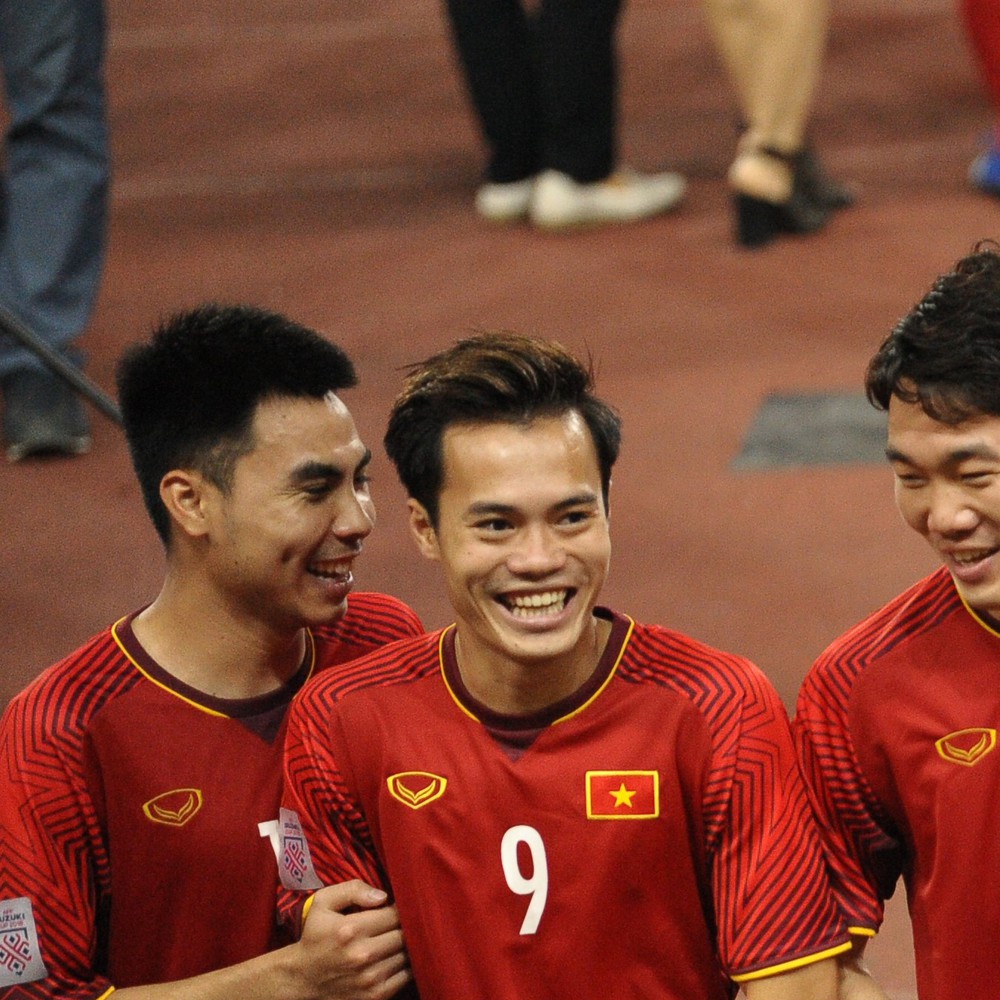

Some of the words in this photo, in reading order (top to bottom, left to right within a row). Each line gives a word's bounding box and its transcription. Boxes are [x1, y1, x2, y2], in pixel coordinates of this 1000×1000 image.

[257, 819, 280, 864] 1
[500, 824, 549, 937] 9
[0, 913, 25, 922] UZUKI
